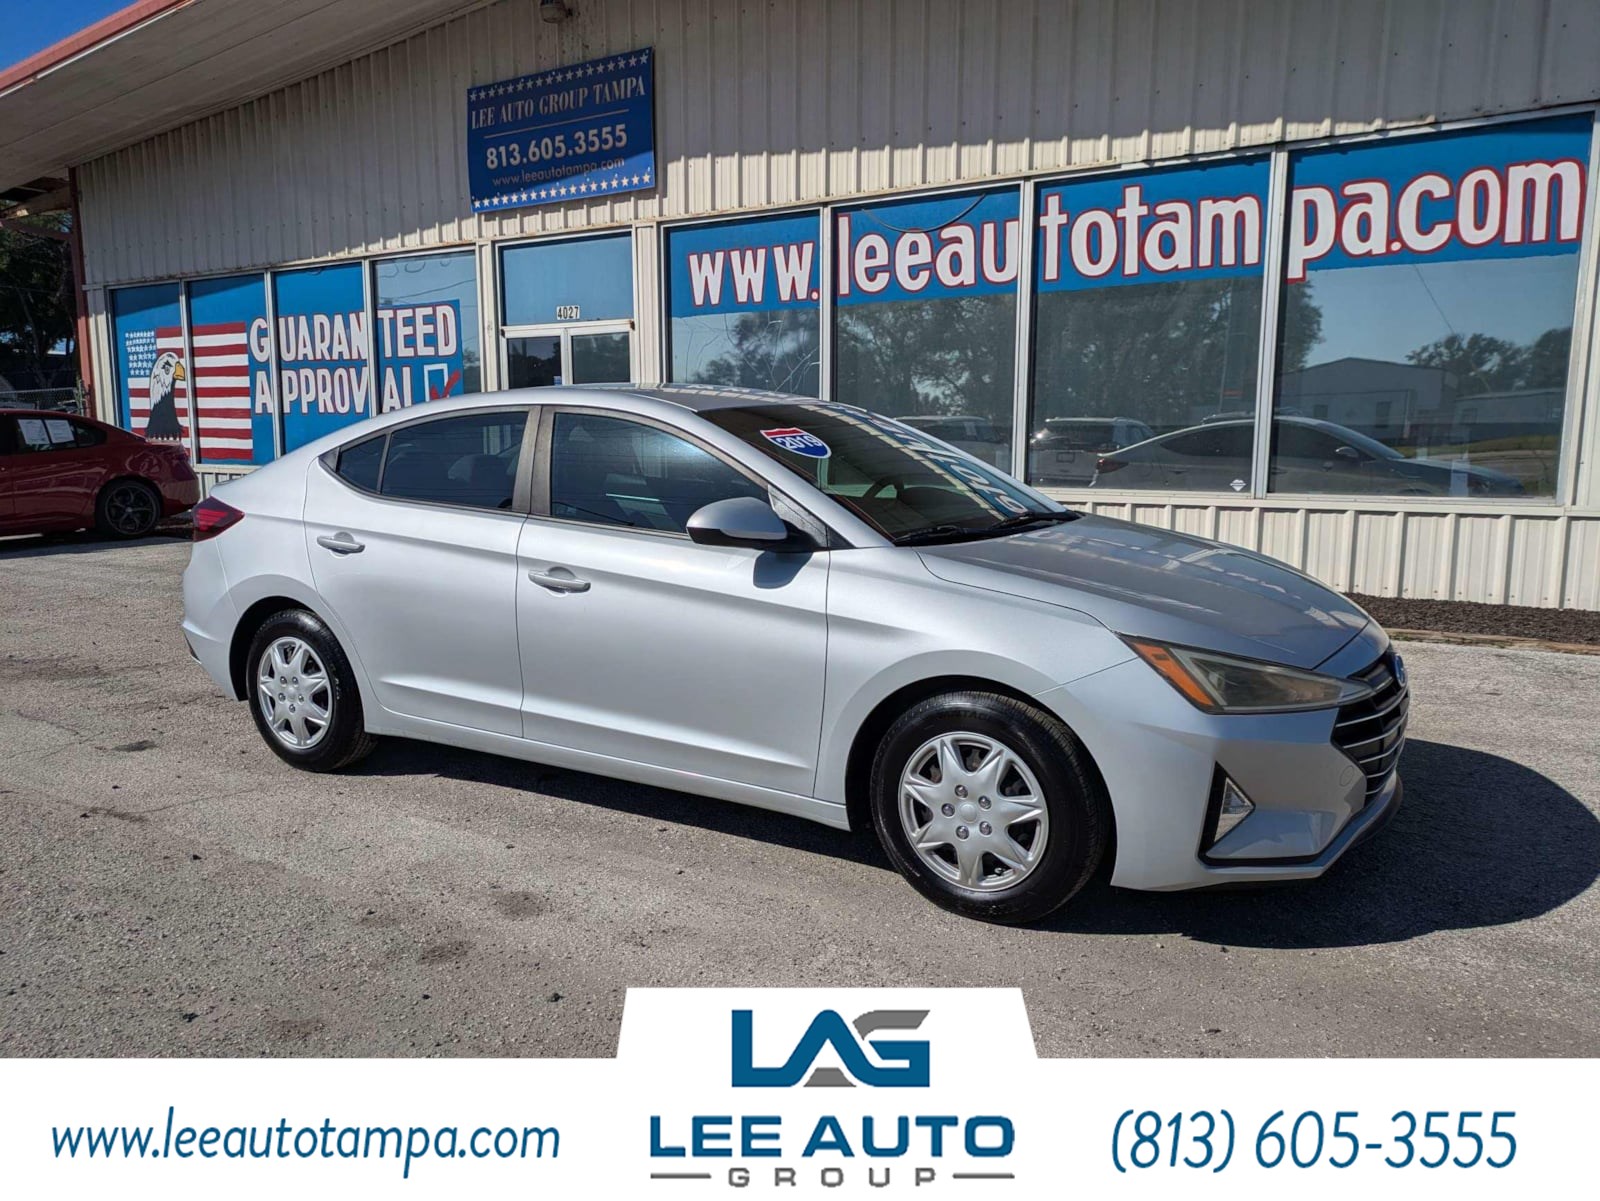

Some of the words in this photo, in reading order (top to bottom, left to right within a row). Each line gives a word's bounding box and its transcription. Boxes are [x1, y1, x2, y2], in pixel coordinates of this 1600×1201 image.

[471, 106, 496, 130] LEE
[500, 99, 535, 122] AUTO
[539, 87, 589, 116] GROUP
[593, 75, 646, 105] TAMPA
[486, 124, 628, 170] 813.605.3555
[492, 157, 625, 187] www.leeautotampa.com
[557, 306, 579, 320] 4027
[775, 435, 823, 449] 2019
